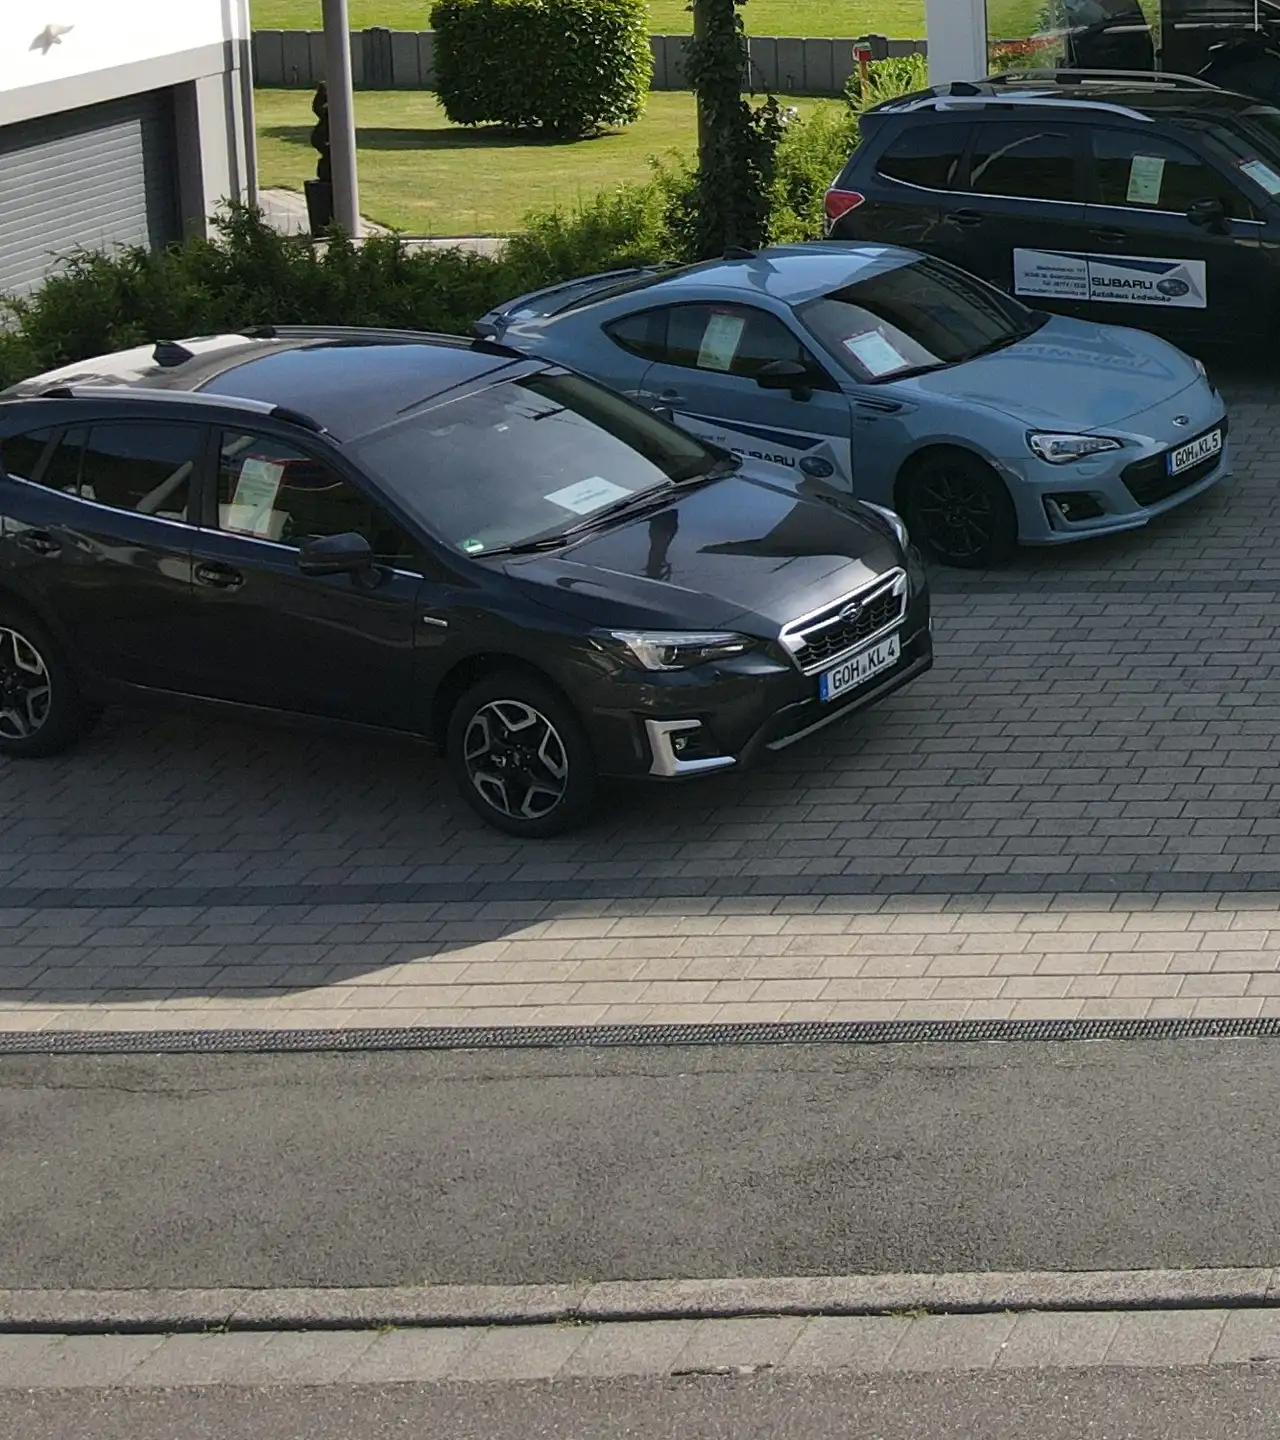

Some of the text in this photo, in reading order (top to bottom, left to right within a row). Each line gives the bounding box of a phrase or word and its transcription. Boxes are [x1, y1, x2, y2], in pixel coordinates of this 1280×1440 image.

[1091, 276, 1154, 290] SUBARU
[1091, 290, 1130, 300] Autohaus
[1131, 293, 1172, 302] Ledwinka
[1175, 432, 1219, 467] GOH KL 5
[833, 640, 896, 690] GOH KL 4
